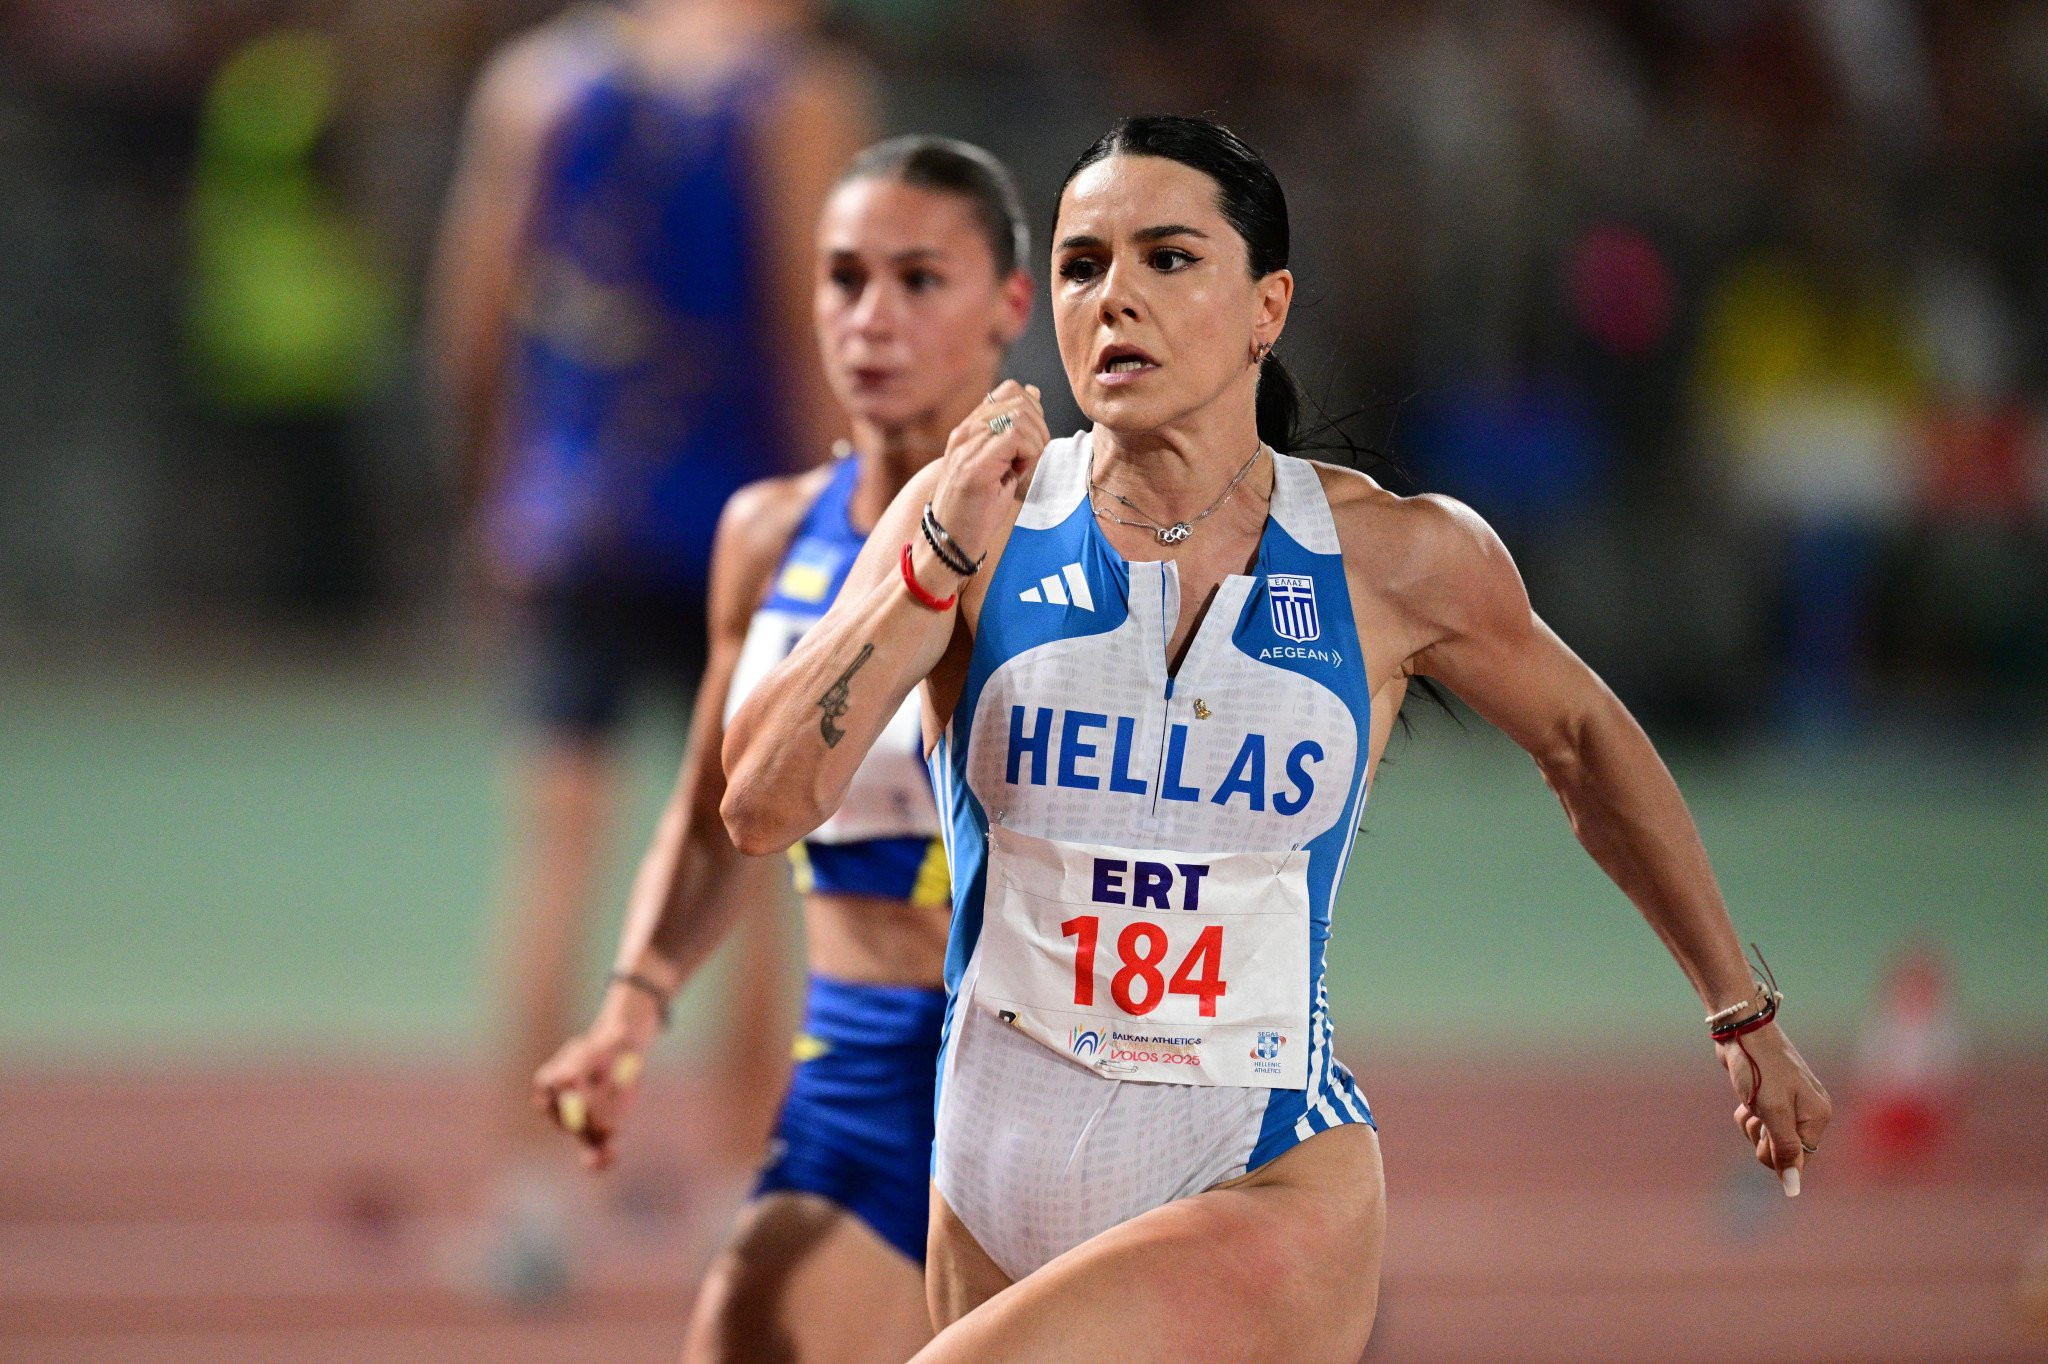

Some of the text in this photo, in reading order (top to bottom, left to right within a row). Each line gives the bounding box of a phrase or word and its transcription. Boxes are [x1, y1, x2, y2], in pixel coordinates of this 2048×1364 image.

[1259, 646, 1329, 663] AEGEAN
[1006, 705, 1325, 816] HELLAS
[1092, 857, 1210, 911] ERT
[1061, 915, 1227, 1018] 184
[1112, 1031, 1202, 1046] BALKAN ATHLETICS
[1110, 1049, 1201, 1067] VOLOS 2025
